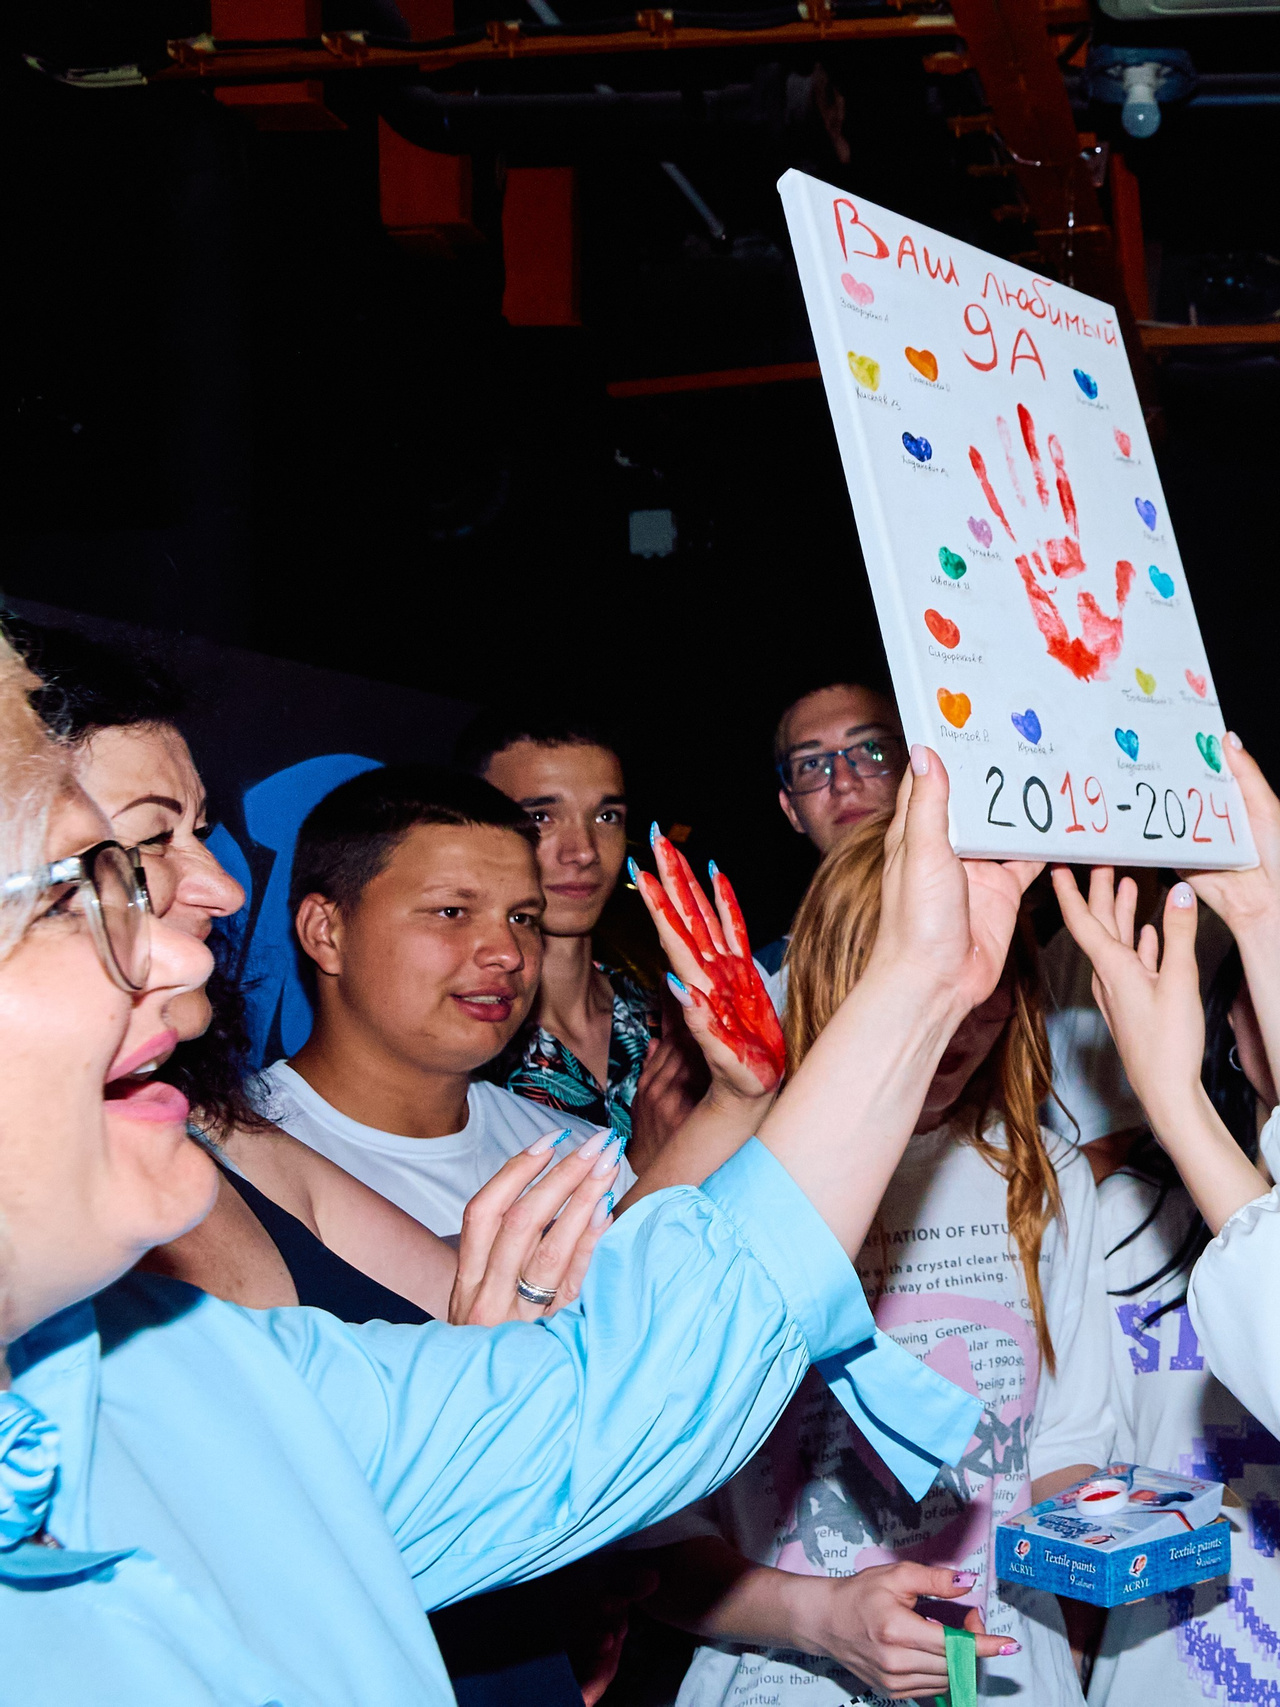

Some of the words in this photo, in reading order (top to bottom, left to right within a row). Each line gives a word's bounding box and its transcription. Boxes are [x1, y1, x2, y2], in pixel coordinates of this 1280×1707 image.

[940, 724, 981, 743] Пирогов
[985, 766, 1237, 845] 2019-2024
[945, 1224, 966, 1240] OF
[905, 1264, 913, 1274] a
[916, 1256, 963, 1276] crystal
[965, 1251, 999, 1267] clear
[898, 1282, 922, 1295] way
[925, 1276, 940, 1291] of
[944, 1270, 1008, 1289] thinking.
[1004, 1300, 1015, 1310] or
[976, 1377, 1005, 1392] being
[1008, 1376, 1016, 1387] a
[1003, 1470, 1025, 1483] one
[924, 1505, 938, 1521] of
[822, 1546, 848, 1559] and
[1169, 1545, 1197, 1562] Textile
[1197, 1537, 1223, 1555] paints
[1009, 1562, 1036, 1578] ACRYL
[1044, 1549, 1071, 1570] Textile
[1071, 1557, 1097, 1576] paints
[1195, 1557, 1202, 1568] 9
[1070, 1573, 1076, 1586] 9
[1122, 1577, 1151, 1594] ACRYL
[990, 1621, 1014, 1635] may
